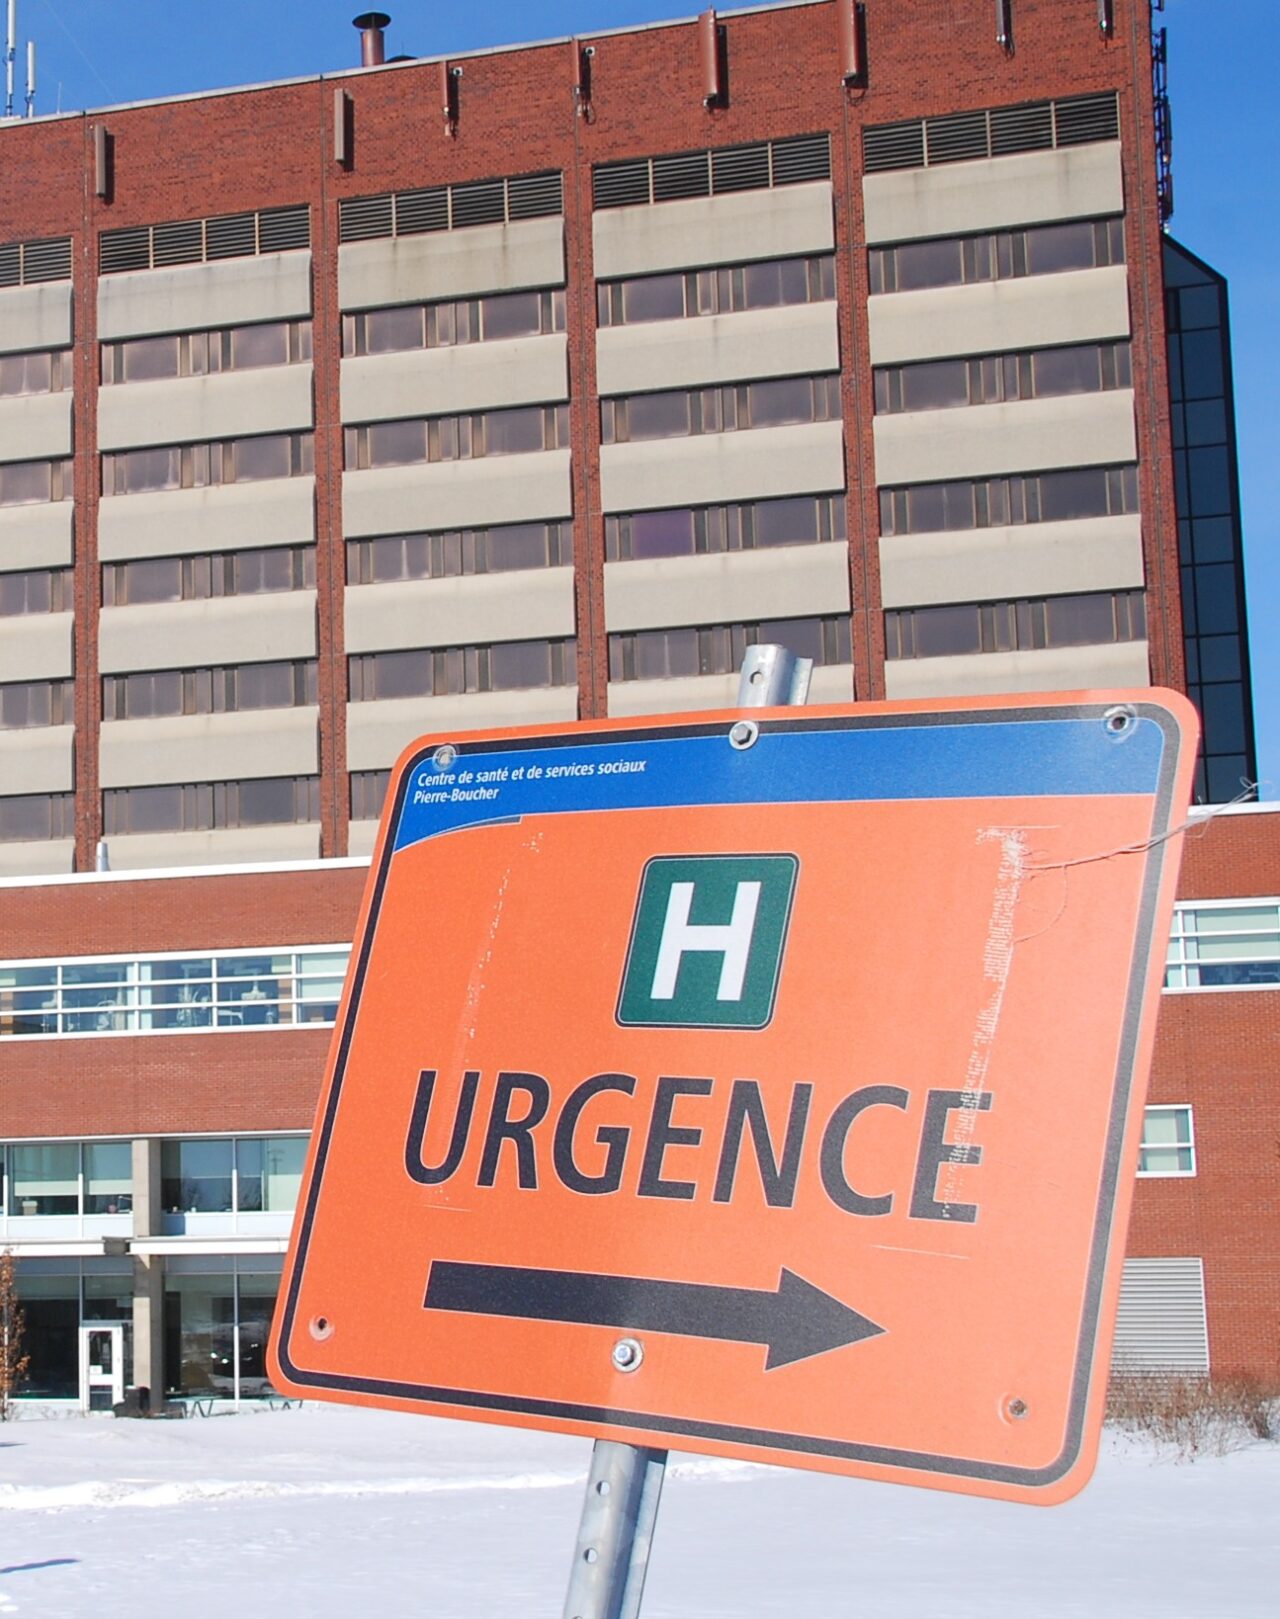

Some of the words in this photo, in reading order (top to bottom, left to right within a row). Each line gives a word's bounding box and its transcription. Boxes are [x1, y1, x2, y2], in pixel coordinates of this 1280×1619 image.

[413, 788, 500, 804] Pierre-Boucher
[417, 772, 455, 787] Centre
[458, 770, 473, 783] de
[476, 766, 508, 783] santé
[511, 767, 524, 781] et
[527, 764, 543, 779] de
[546, 761, 595, 778] services
[597, 759, 646, 775] sociaux
[650, 881, 762, 1001] H
[404, 1069, 993, 1224] URGENCE
